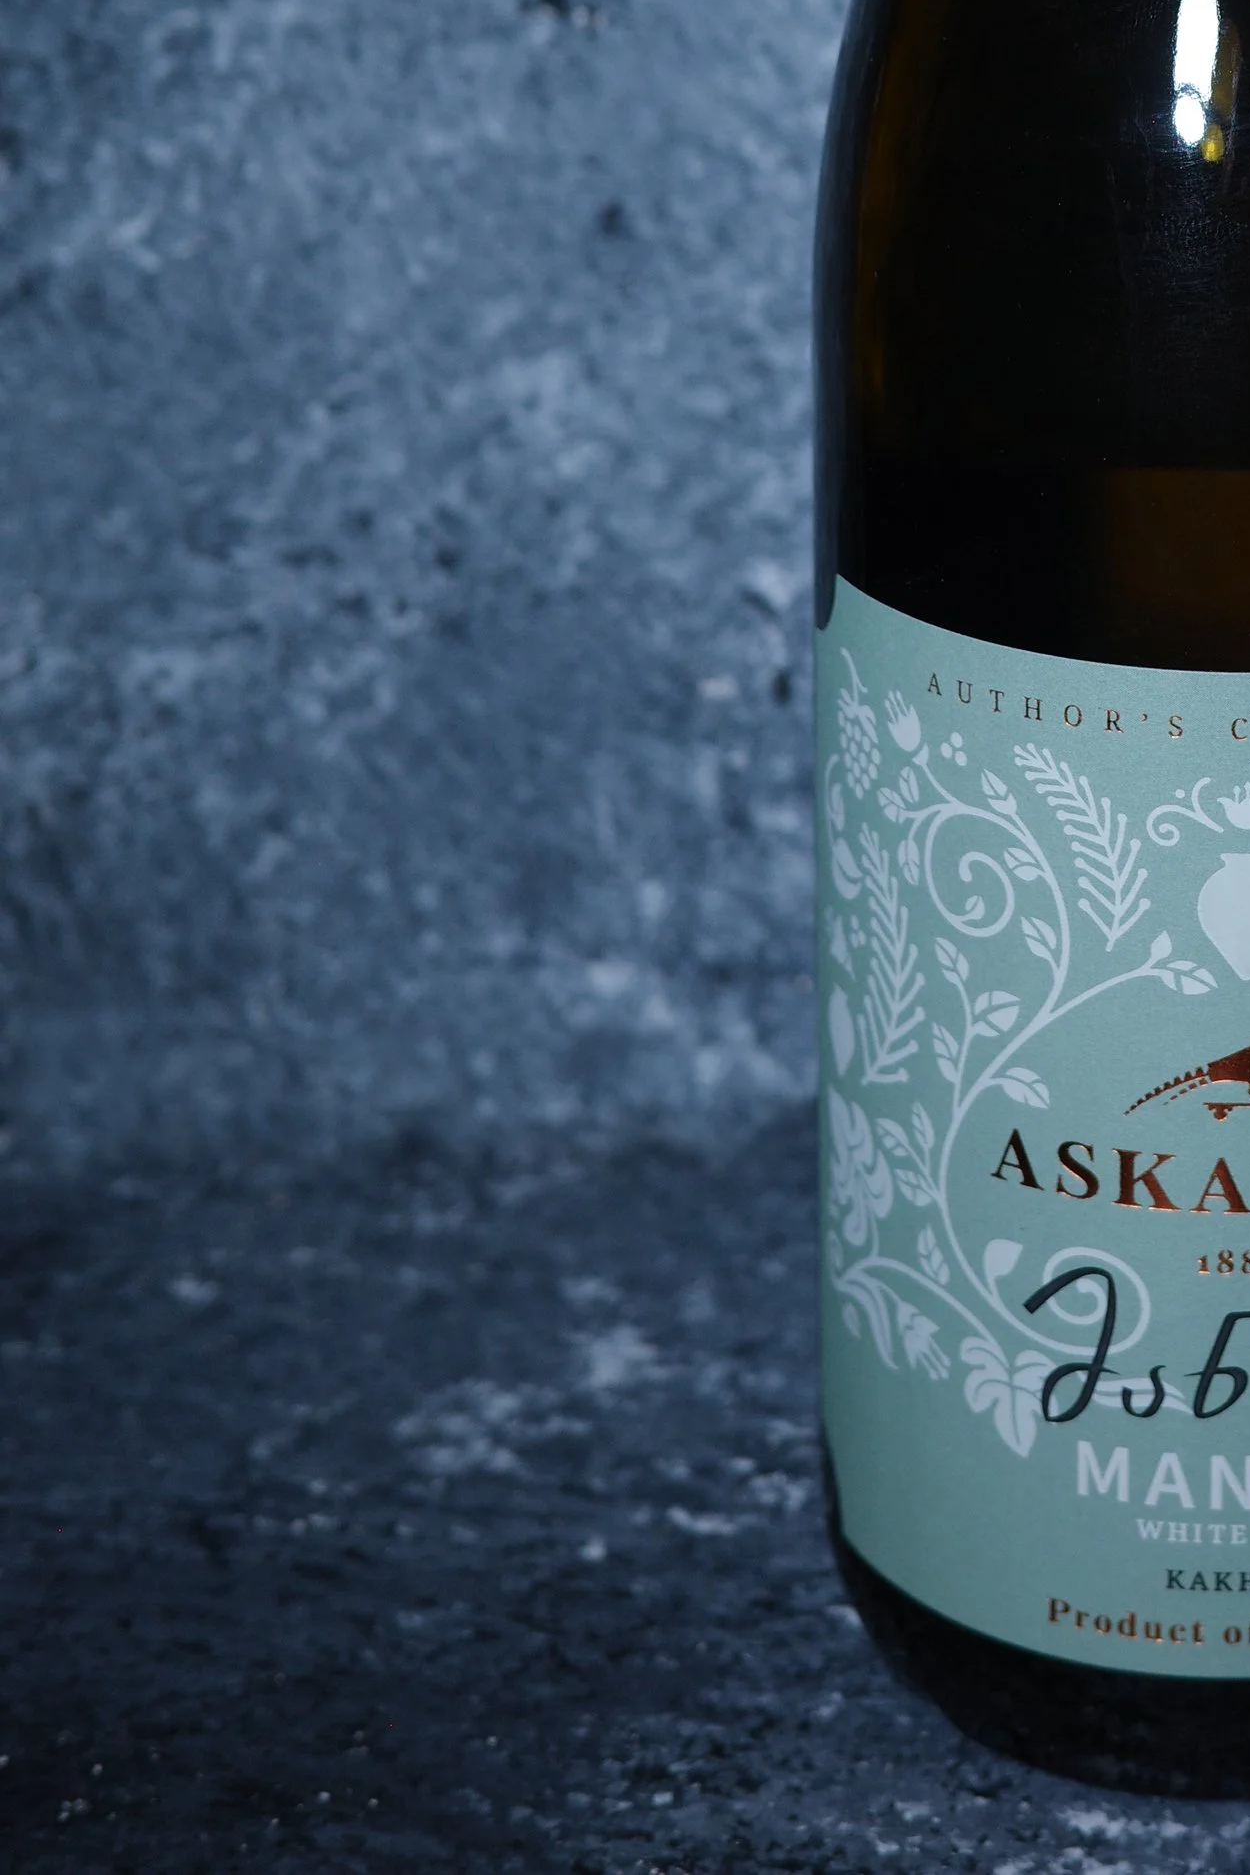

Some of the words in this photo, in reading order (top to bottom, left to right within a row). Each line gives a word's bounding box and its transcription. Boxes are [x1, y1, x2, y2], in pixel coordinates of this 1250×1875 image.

[926, 672, 1184, 738] AUTHOR'S
[1137, 1518, 1247, 1544] WHITE
[1048, 1597, 1206, 1645] Product
